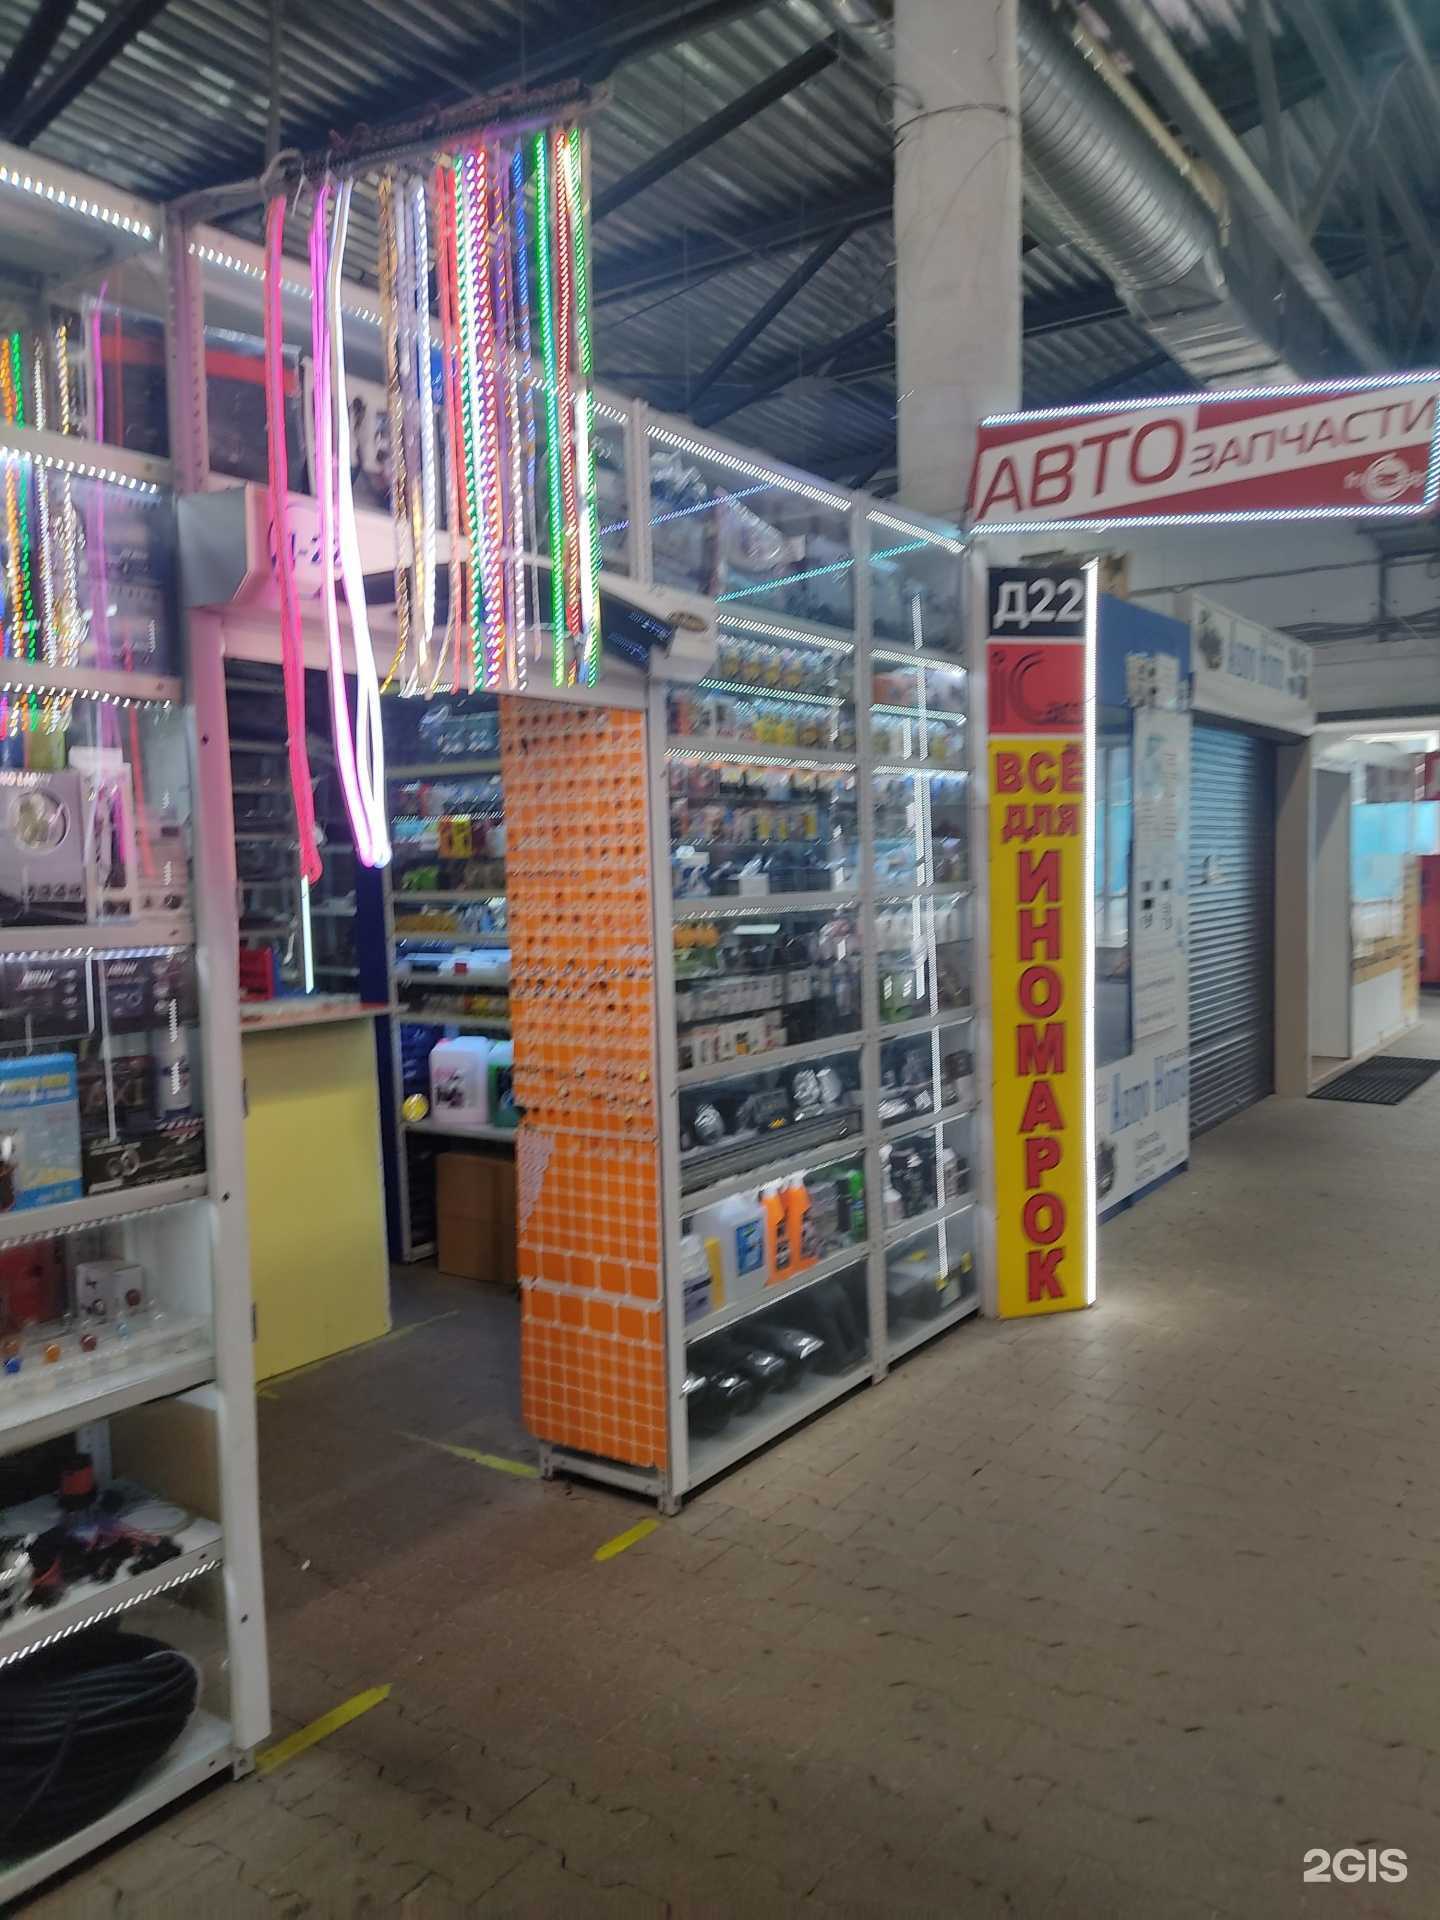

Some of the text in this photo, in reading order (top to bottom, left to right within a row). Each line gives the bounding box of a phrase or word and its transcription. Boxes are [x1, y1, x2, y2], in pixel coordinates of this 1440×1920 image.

[974, 417, 1184, 522] АВТО
[992, 576, 1084, 630] Д22
[1015, 850, 1066, 1302] ИНОМАРОК
